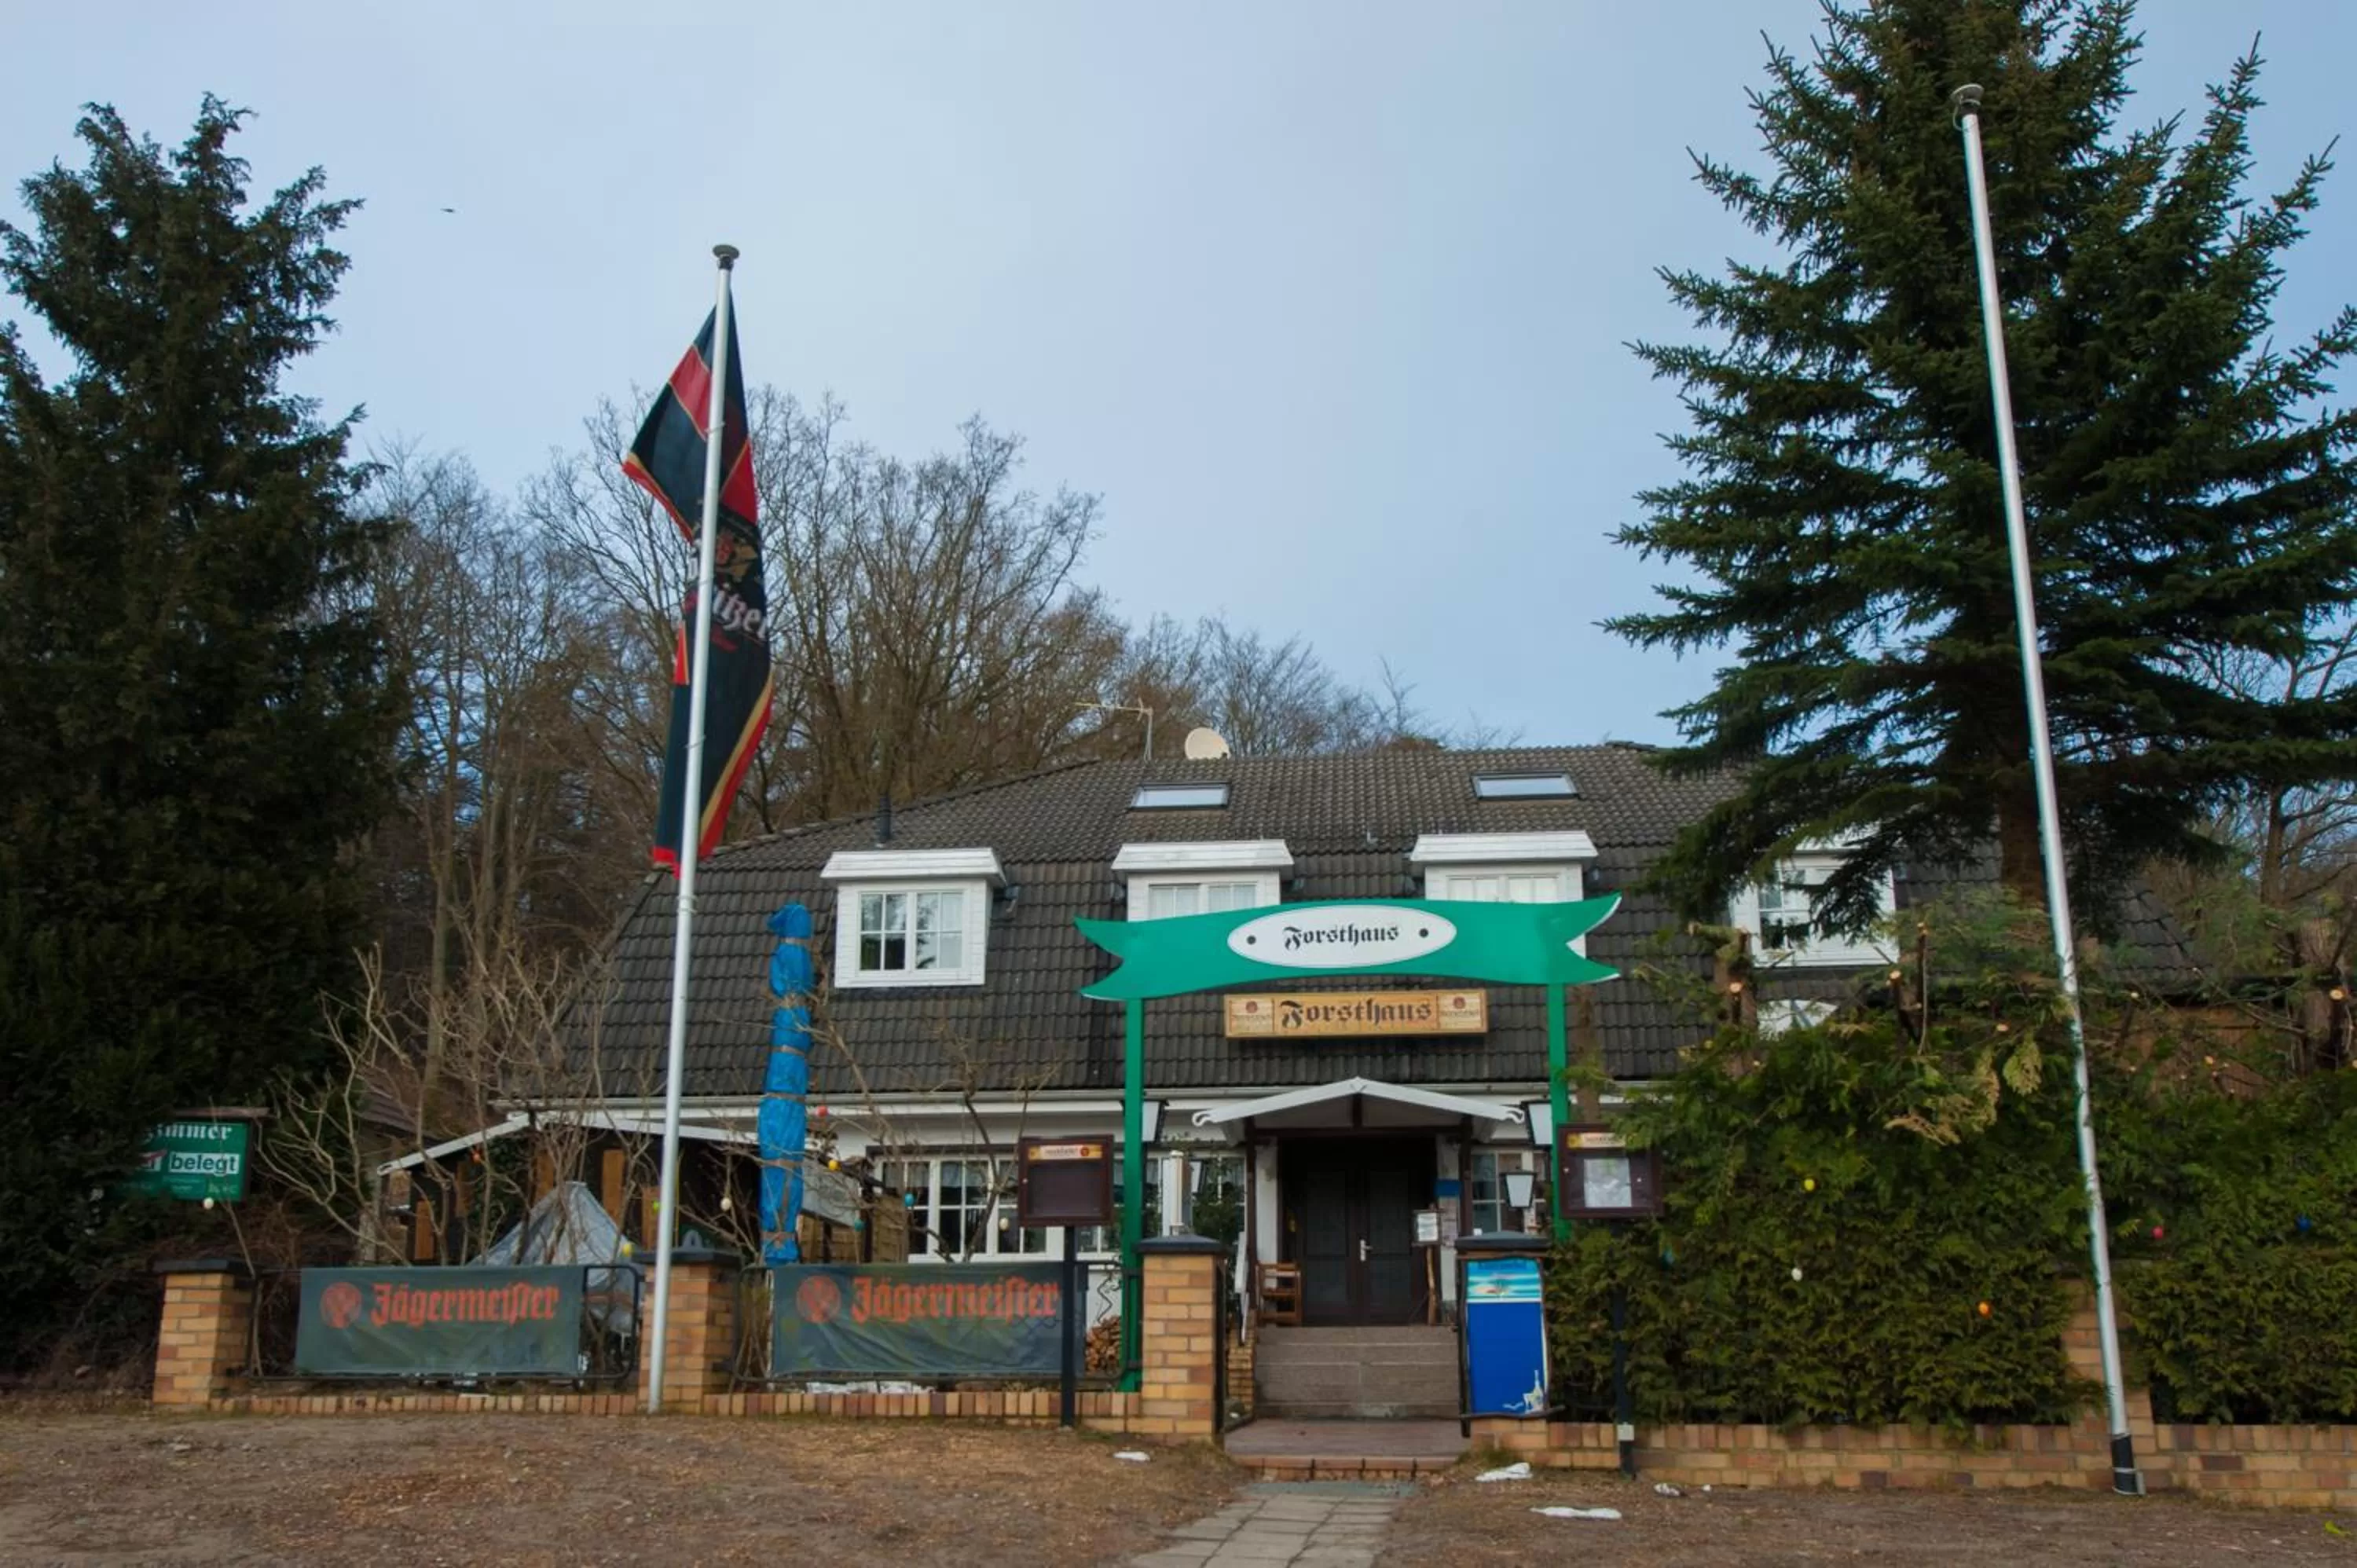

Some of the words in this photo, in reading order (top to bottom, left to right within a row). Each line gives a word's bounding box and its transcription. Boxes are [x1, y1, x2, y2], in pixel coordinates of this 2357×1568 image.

[1283, 922, 1399, 951] Forsthaus
[1280, 997, 1431, 1030] Forsthaus
[170, 1154, 236, 1177] belegt
[370, 1281, 561, 1328] Jägermeister
[850, 1275, 1061, 1324] Jägermeister
